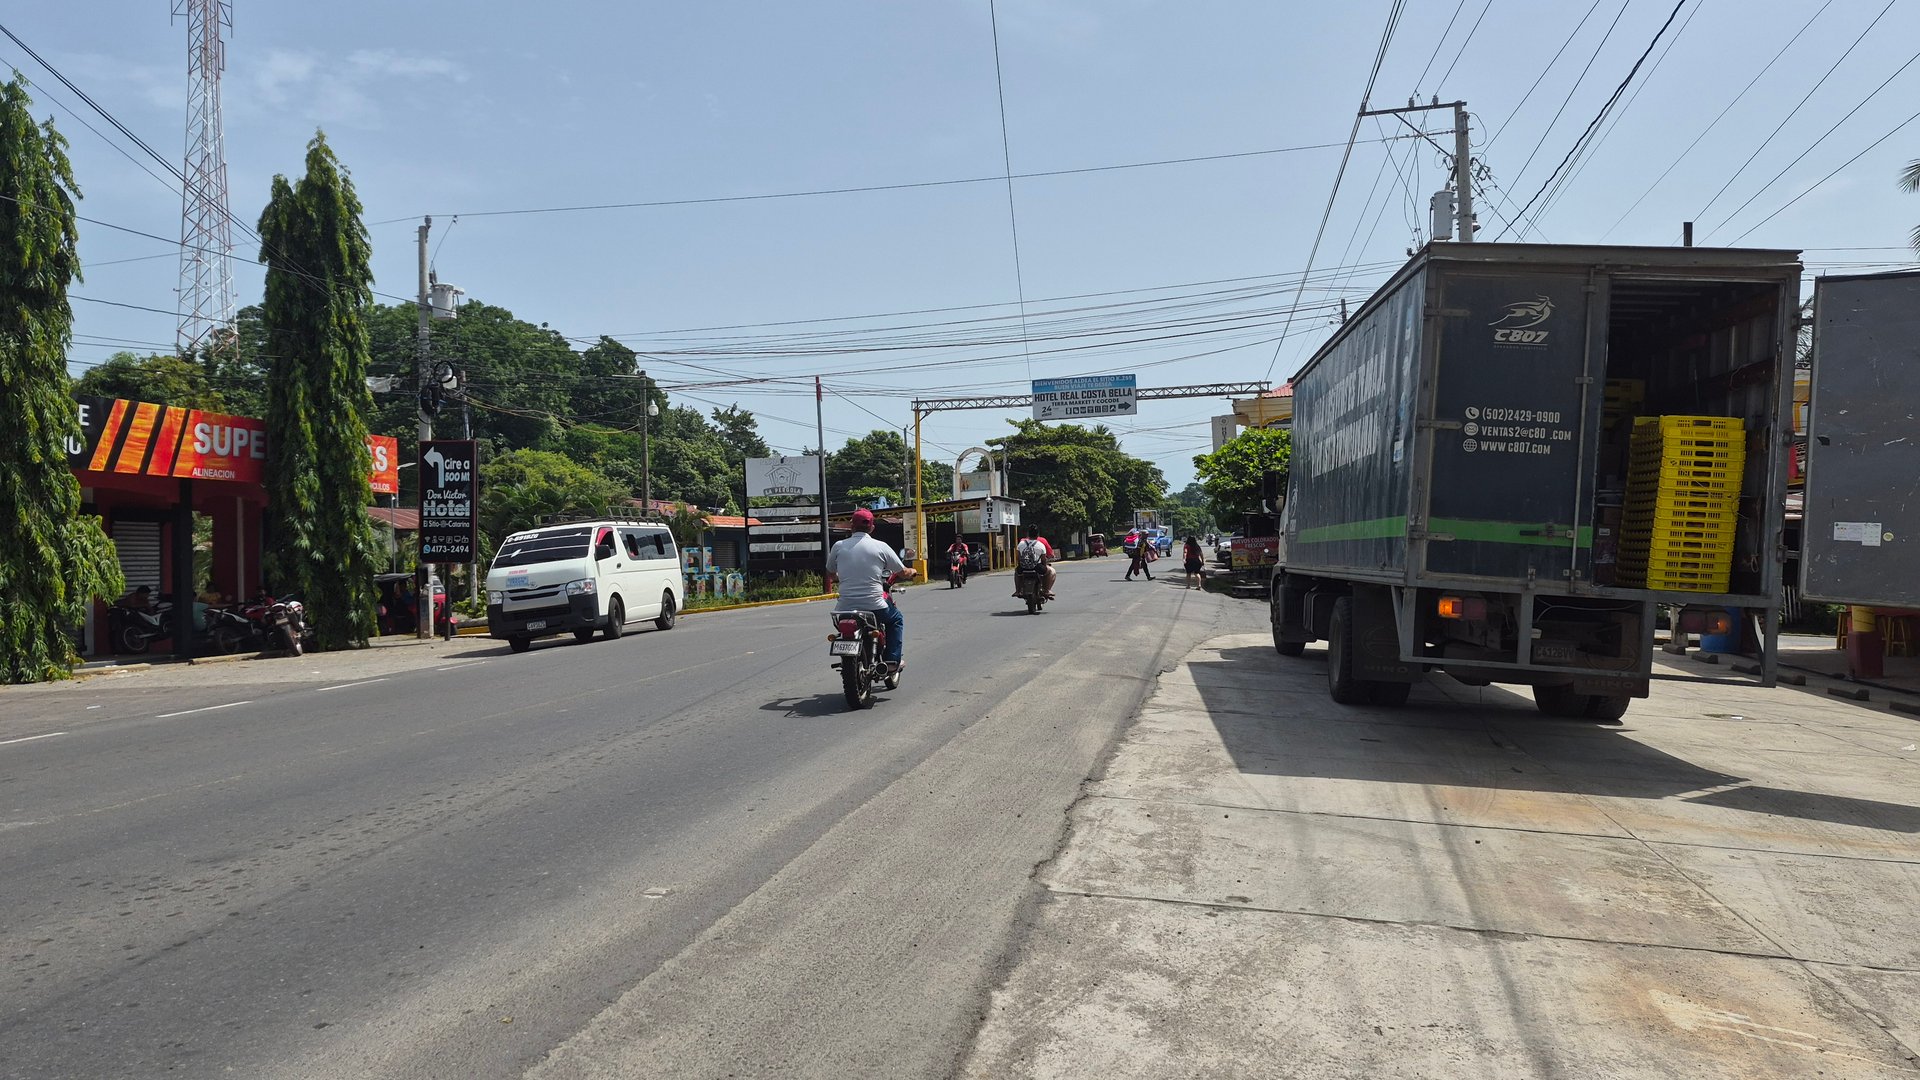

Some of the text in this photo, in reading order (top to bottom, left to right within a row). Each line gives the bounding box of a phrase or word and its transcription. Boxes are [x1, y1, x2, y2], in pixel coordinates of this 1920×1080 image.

[1494, 329, 1549, 343] C807
[1035, 387, 1133, 402] HOTEL REAL COSTA BELLA
[1482, 406, 1560, 423] (502)2429-0900
[444, 457, 470, 470] Gire a
[192, 467, 235, 479] ALINEACION
[444, 472, 460, 481] 500
[426, 489, 467, 500] Don Victor
[423, 500, 470, 516] Hotel
[431, 545, 470, 553] 4173-2494
